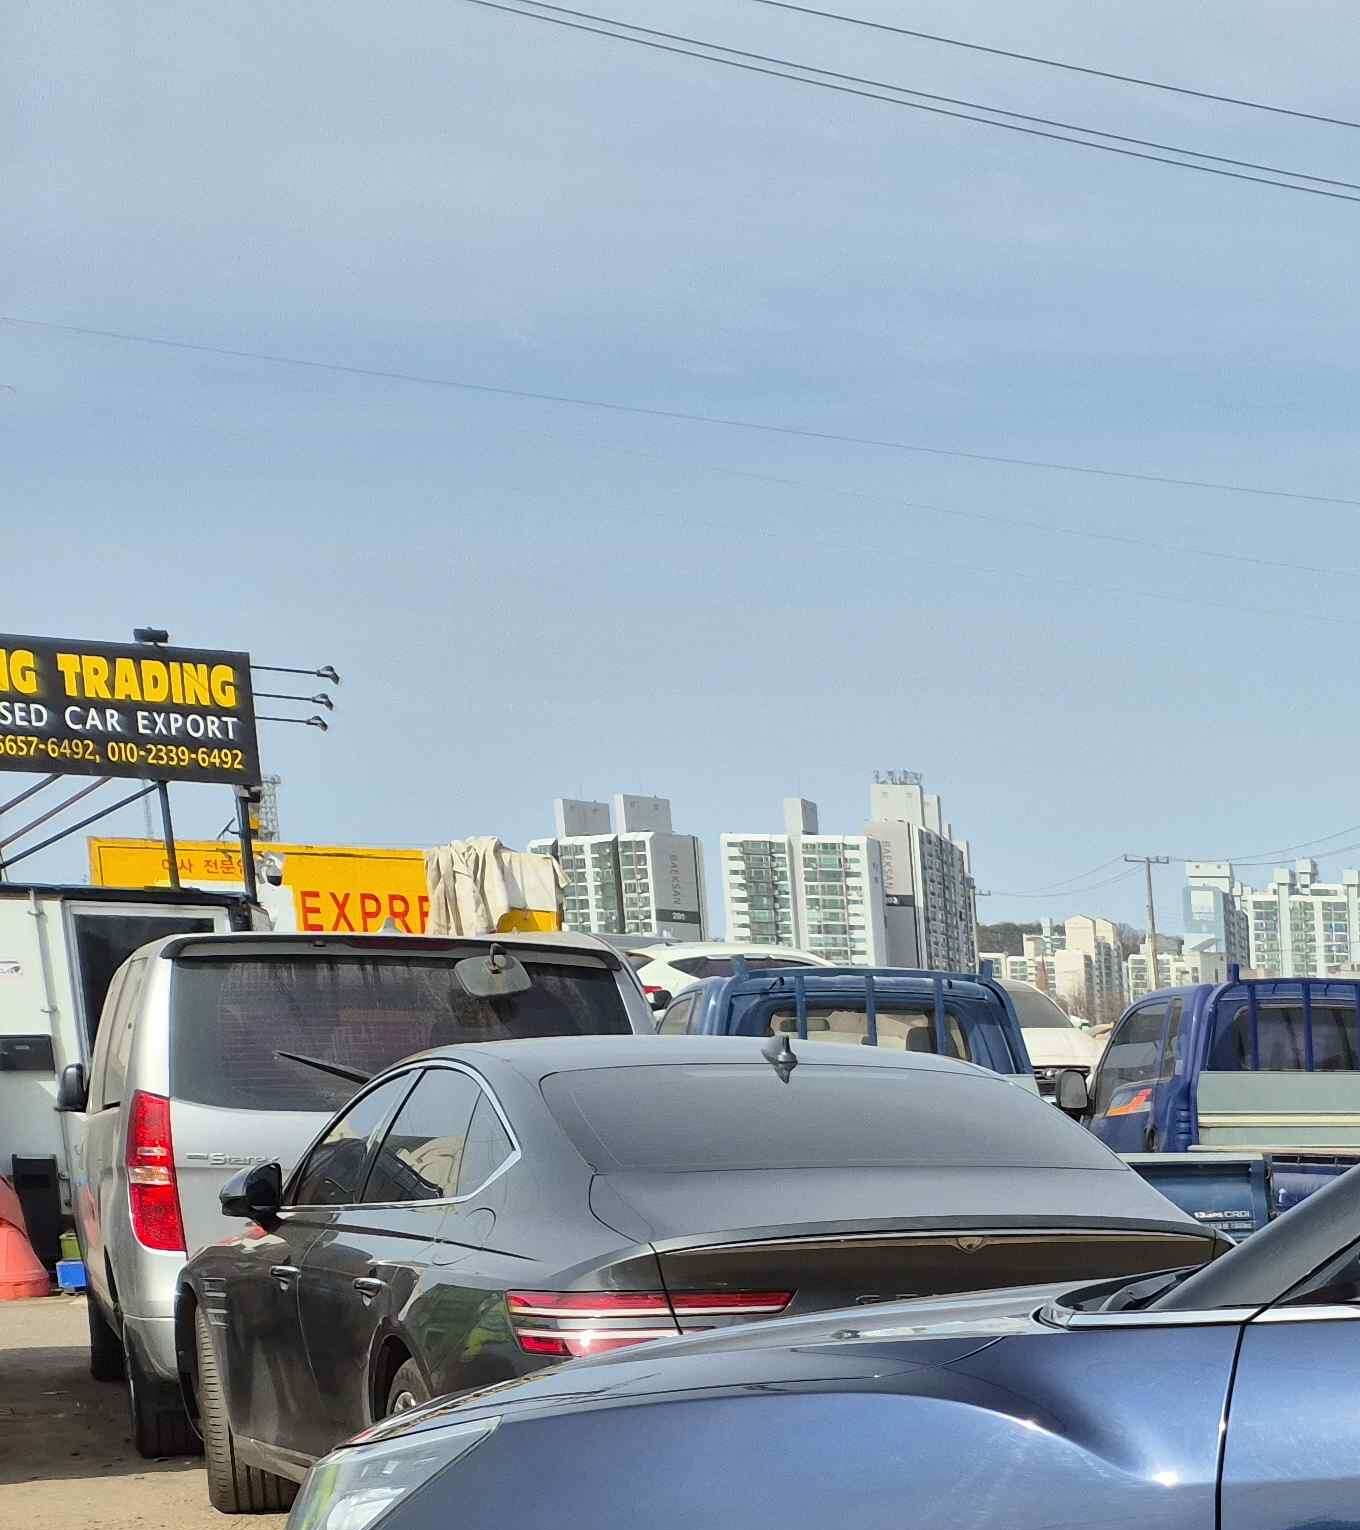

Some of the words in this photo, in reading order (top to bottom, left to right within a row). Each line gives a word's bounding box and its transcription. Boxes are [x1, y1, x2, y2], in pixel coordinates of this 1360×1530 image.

[56, 653, 237, 709] TRADING
[64, 705, 123, 732] CAR
[136, 710, 240, 741] EXPORT
[107, 741, 245, 769] 010-2339-6492
